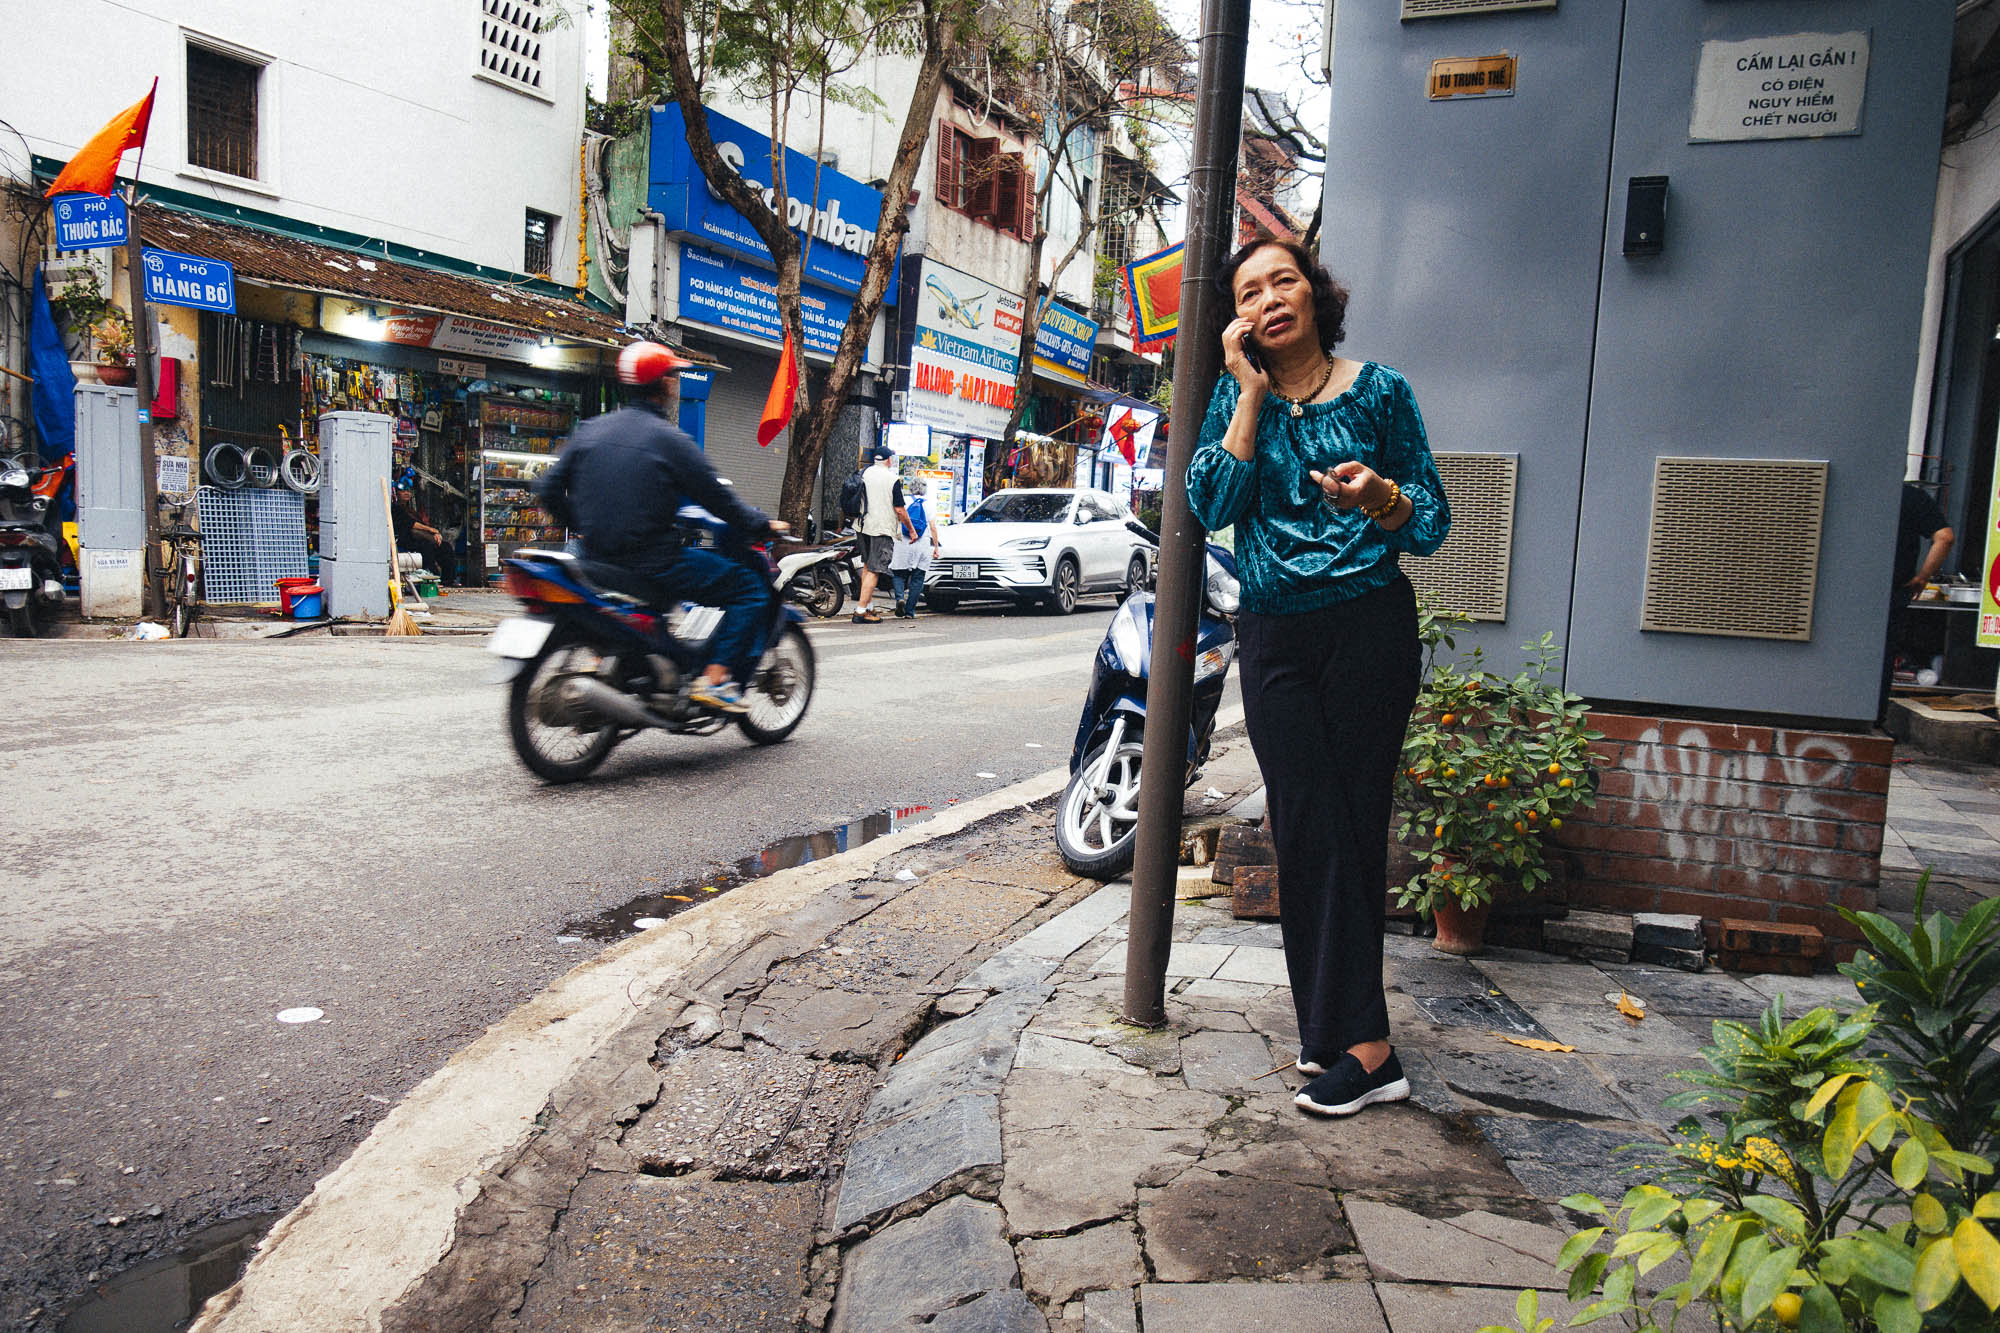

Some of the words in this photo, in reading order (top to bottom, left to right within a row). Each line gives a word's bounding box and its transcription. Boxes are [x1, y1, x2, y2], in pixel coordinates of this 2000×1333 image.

[1736, 51, 1773, 71] CẤM
[1778, 54, 1804, 72] LẠI
[1809, 46, 1845, 67] GẦN
[1454, 71, 1486, 88] TRUNG
[1761, 78, 1784, 92] CÓ
[1788, 76, 1824, 92] ĐIỆN
[1748, 97, 1792, 110] NGUY
[1796, 90, 1834, 107] HIỂM
[1742, 110, 1783, 127] CHẾT
[1787, 108, 1837, 125] NGƯỜI
[62, 216, 98, 241] THUỐC
[101, 211, 123, 237] BẮC
[686, 247, 725, 269] Sacombank
[179, 262, 208, 276] PHỐ
[152, 273, 201, 300] HÀNG
[689, 277, 704, 289] PGD
[937, 333, 979, 362] Vietnam
[979, 347, 1013, 372] Airlines
[916, 361, 954, 395] HALONG
[961, 373, 986, 403] SAPA
[986, 380, 1015, 410] TRAVEL
